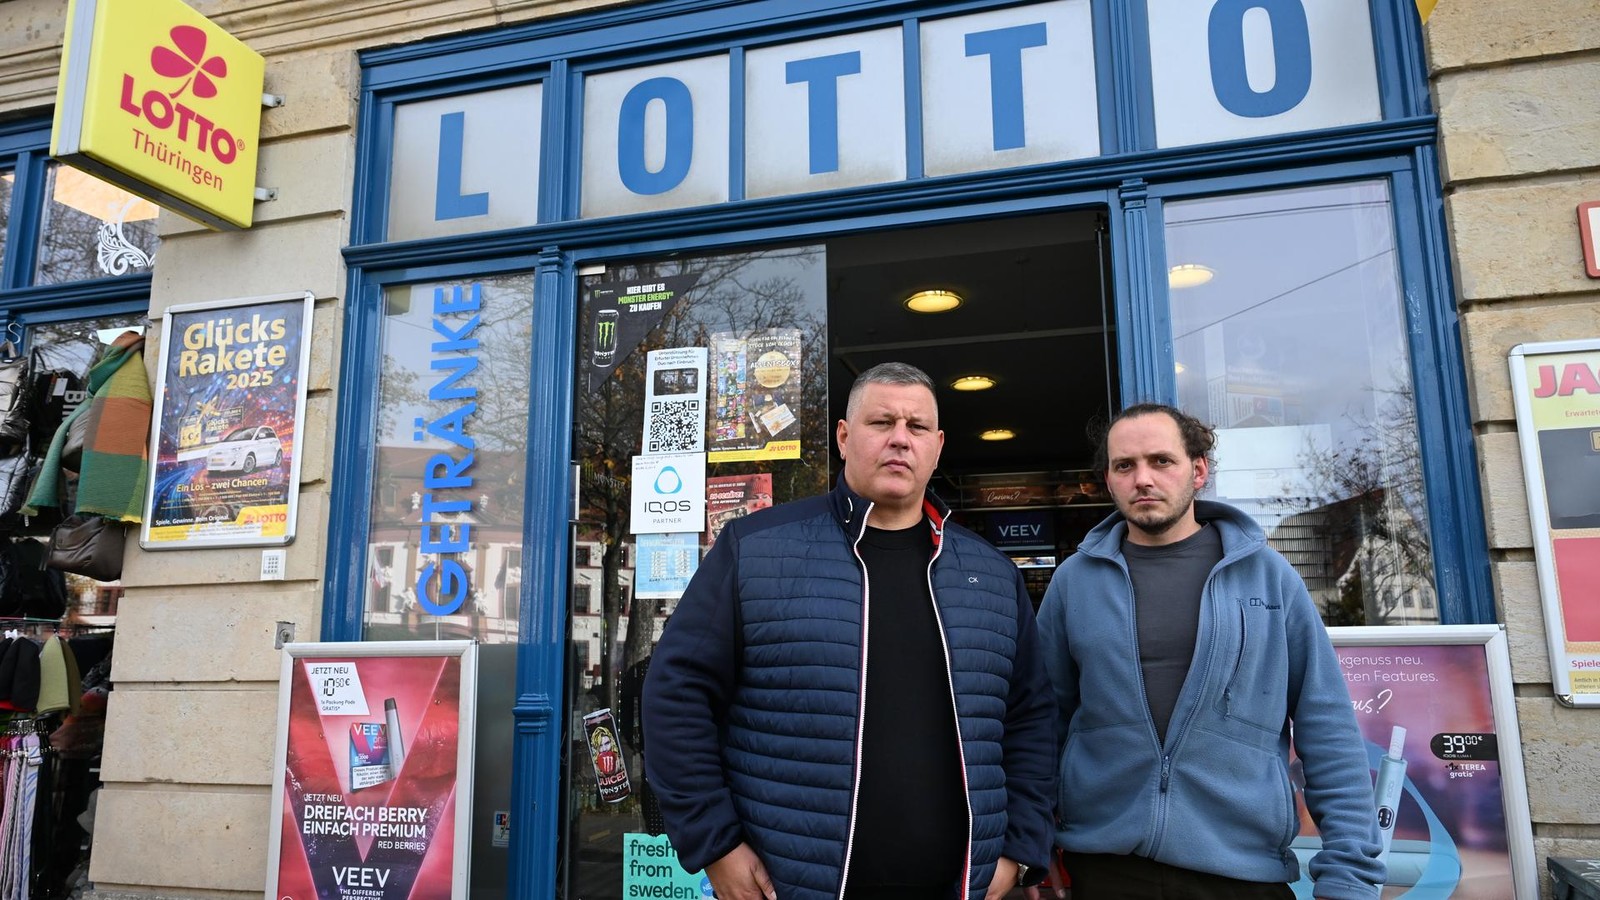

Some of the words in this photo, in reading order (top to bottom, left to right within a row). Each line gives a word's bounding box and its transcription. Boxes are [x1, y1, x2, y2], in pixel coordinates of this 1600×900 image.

[132, 128, 223, 191] Thüringen
[627, 286, 641, 294] HIER
[642, 284, 656, 293] GIBT
[657, 283, 665, 291] ES
[618, 295, 646, 304] MONSTER
[629, 304, 638, 312] ZU
[638, 301, 662, 311] KAUFEN
[184, 314, 286, 350] Glücks
[179, 341, 286, 377] Rakete
[226, 370, 273, 389] 2025
[1534, 362, 1600, 398] JA
[414, 283, 481, 616] GETRÄNKE
[176, 484, 189, 493] Ein
[190, 482, 204, 491] Los
[211, 479, 230, 490] zwei
[231, 477, 268, 488] Chancen
[987, 491, 1020, 503] Curious?
[644, 500, 691, 514] IQOS
[256, 513, 287, 523] LOTTO
[998, 524, 1041, 537] VEEV
[1338, 654, 1392, 668] kgenuss
[1396, 654, 1424, 665] neu.
[1374, 670, 1439, 682] Features.
[353, 724, 386, 736] VEEV
[599, 770, 626, 786] JUICED
[303, 794, 325, 802] JETZT
[327, 794, 343, 802] NEU
[304, 805, 374, 821] DREIFACH
[378, 807, 428, 823] BERRY
[303, 821, 359, 836] EINFACH
[362, 823, 426, 838] PREMIUM
[378, 841, 393, 849] RED
[395, 842, 426, 851] BERRIES
[629, 839, 675, 857] fresh
[629, 859, 672, 877] from
[332, 866, 391, 888] VEEV
[629, 881, 699, 899] sweden.
